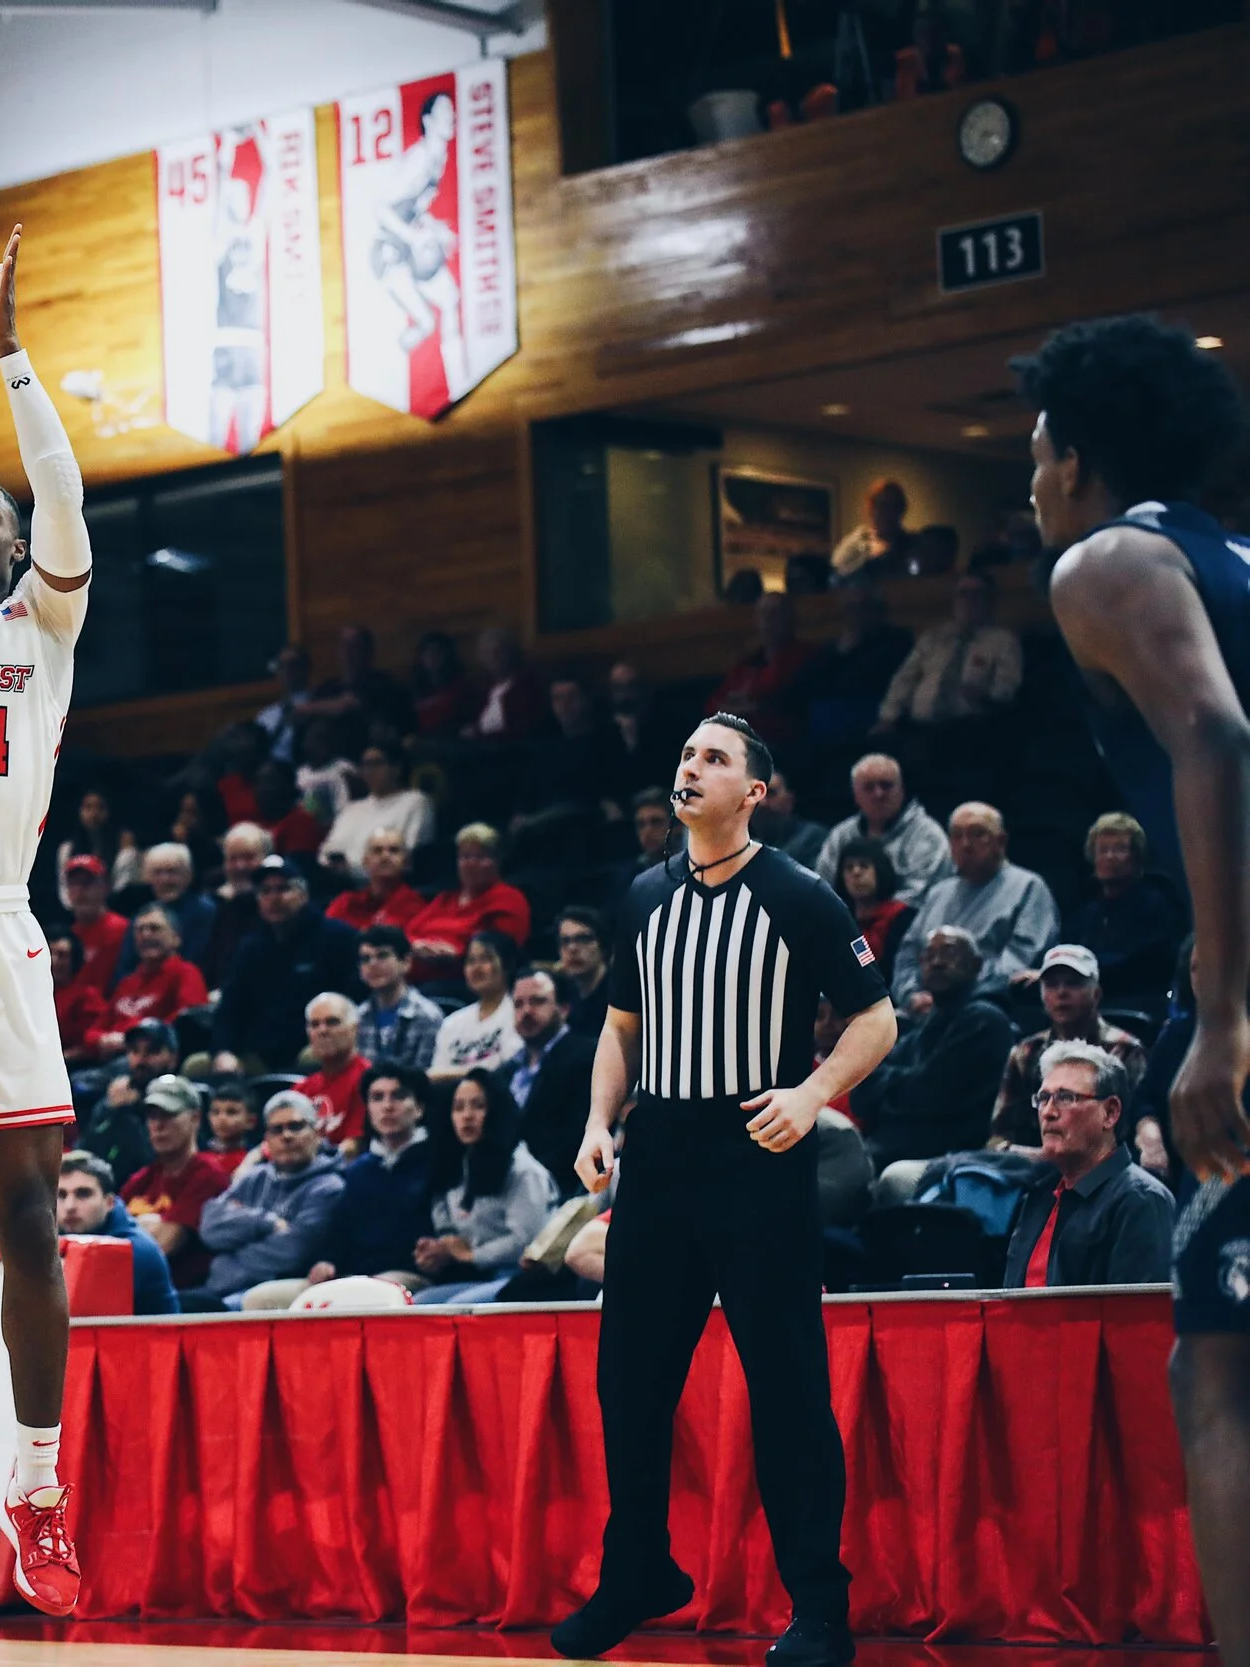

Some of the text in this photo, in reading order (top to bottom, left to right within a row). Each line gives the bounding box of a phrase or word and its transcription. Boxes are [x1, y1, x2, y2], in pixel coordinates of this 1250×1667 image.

[349, 107, 395, 165] 12
[167, 153, 209, 208] 45
[960, 228, 1023, 276] 113
